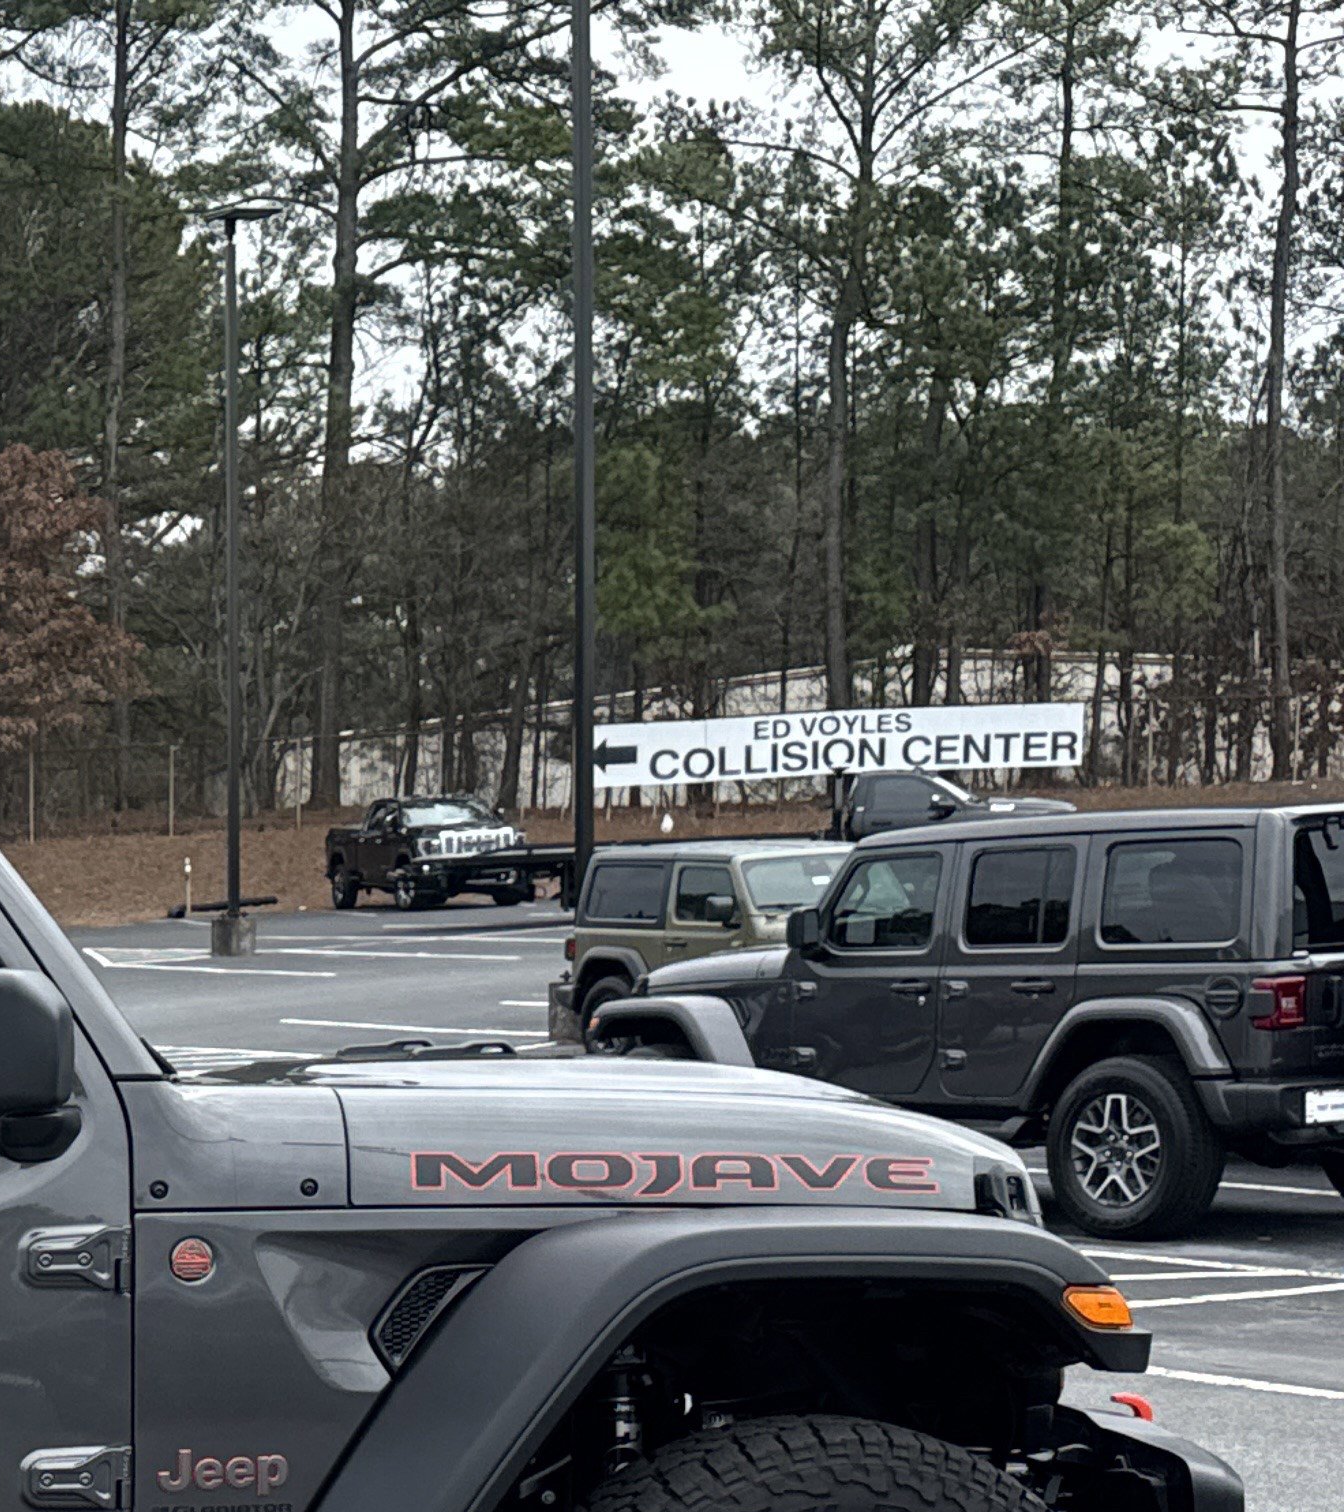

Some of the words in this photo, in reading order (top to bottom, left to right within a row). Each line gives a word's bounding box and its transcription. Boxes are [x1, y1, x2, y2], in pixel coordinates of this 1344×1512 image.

[753, 717, 791, 741] ED
[803, 712, 913, 737] VOYLES
[649, 738, 887, 780] COLLISION
[901, 730, 1079, 766] CENTER
[410, 1151, 940, 1197] MOJAVE
[158, 1448, 288, 1496] Jeep
